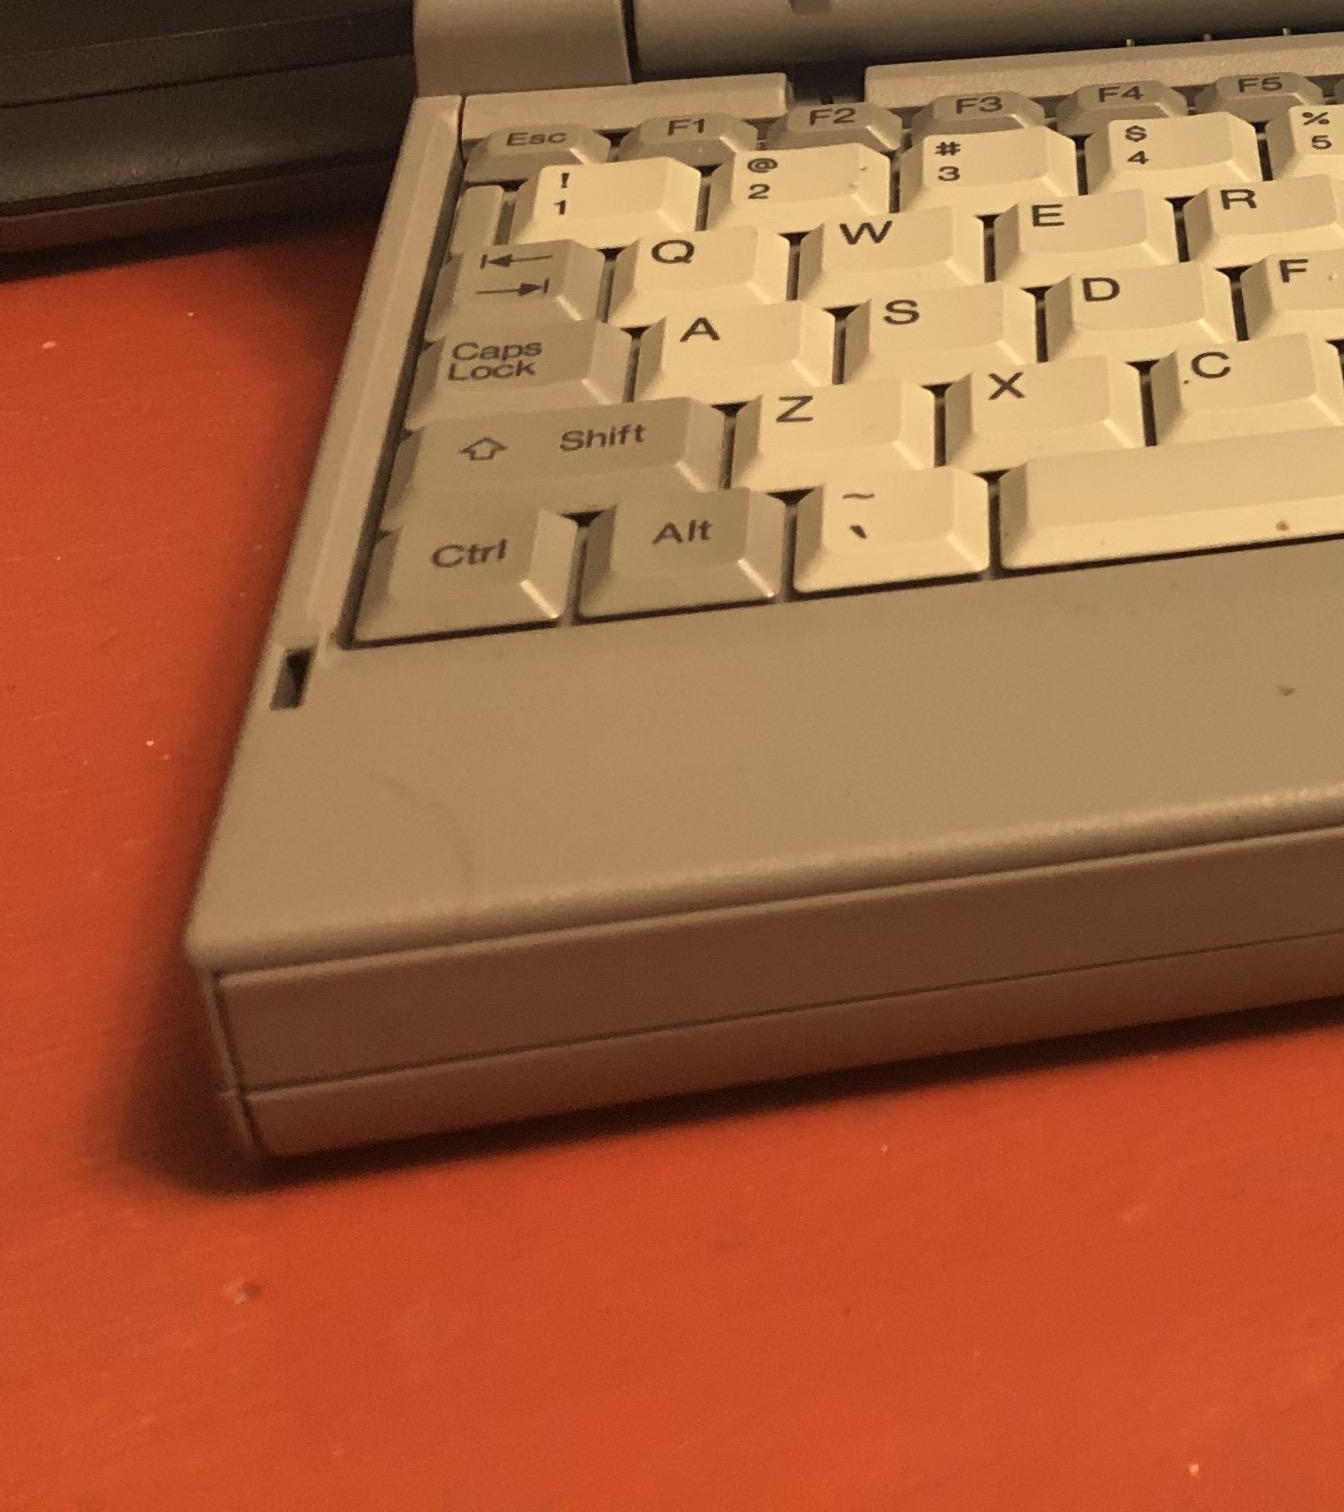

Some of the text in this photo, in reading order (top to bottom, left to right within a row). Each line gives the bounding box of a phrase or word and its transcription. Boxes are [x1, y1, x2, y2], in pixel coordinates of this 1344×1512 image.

[505, 130, 568, 147] Esc
[667, 118, 707, 137] F1
[451, 340, 543, 363] Caps
[446, 359, 538, 382] Lock
[559, 423, 648, 453] Shift
[650, 518, 713, 546] Alt
[430, 538, 509, 571] Ctrl
